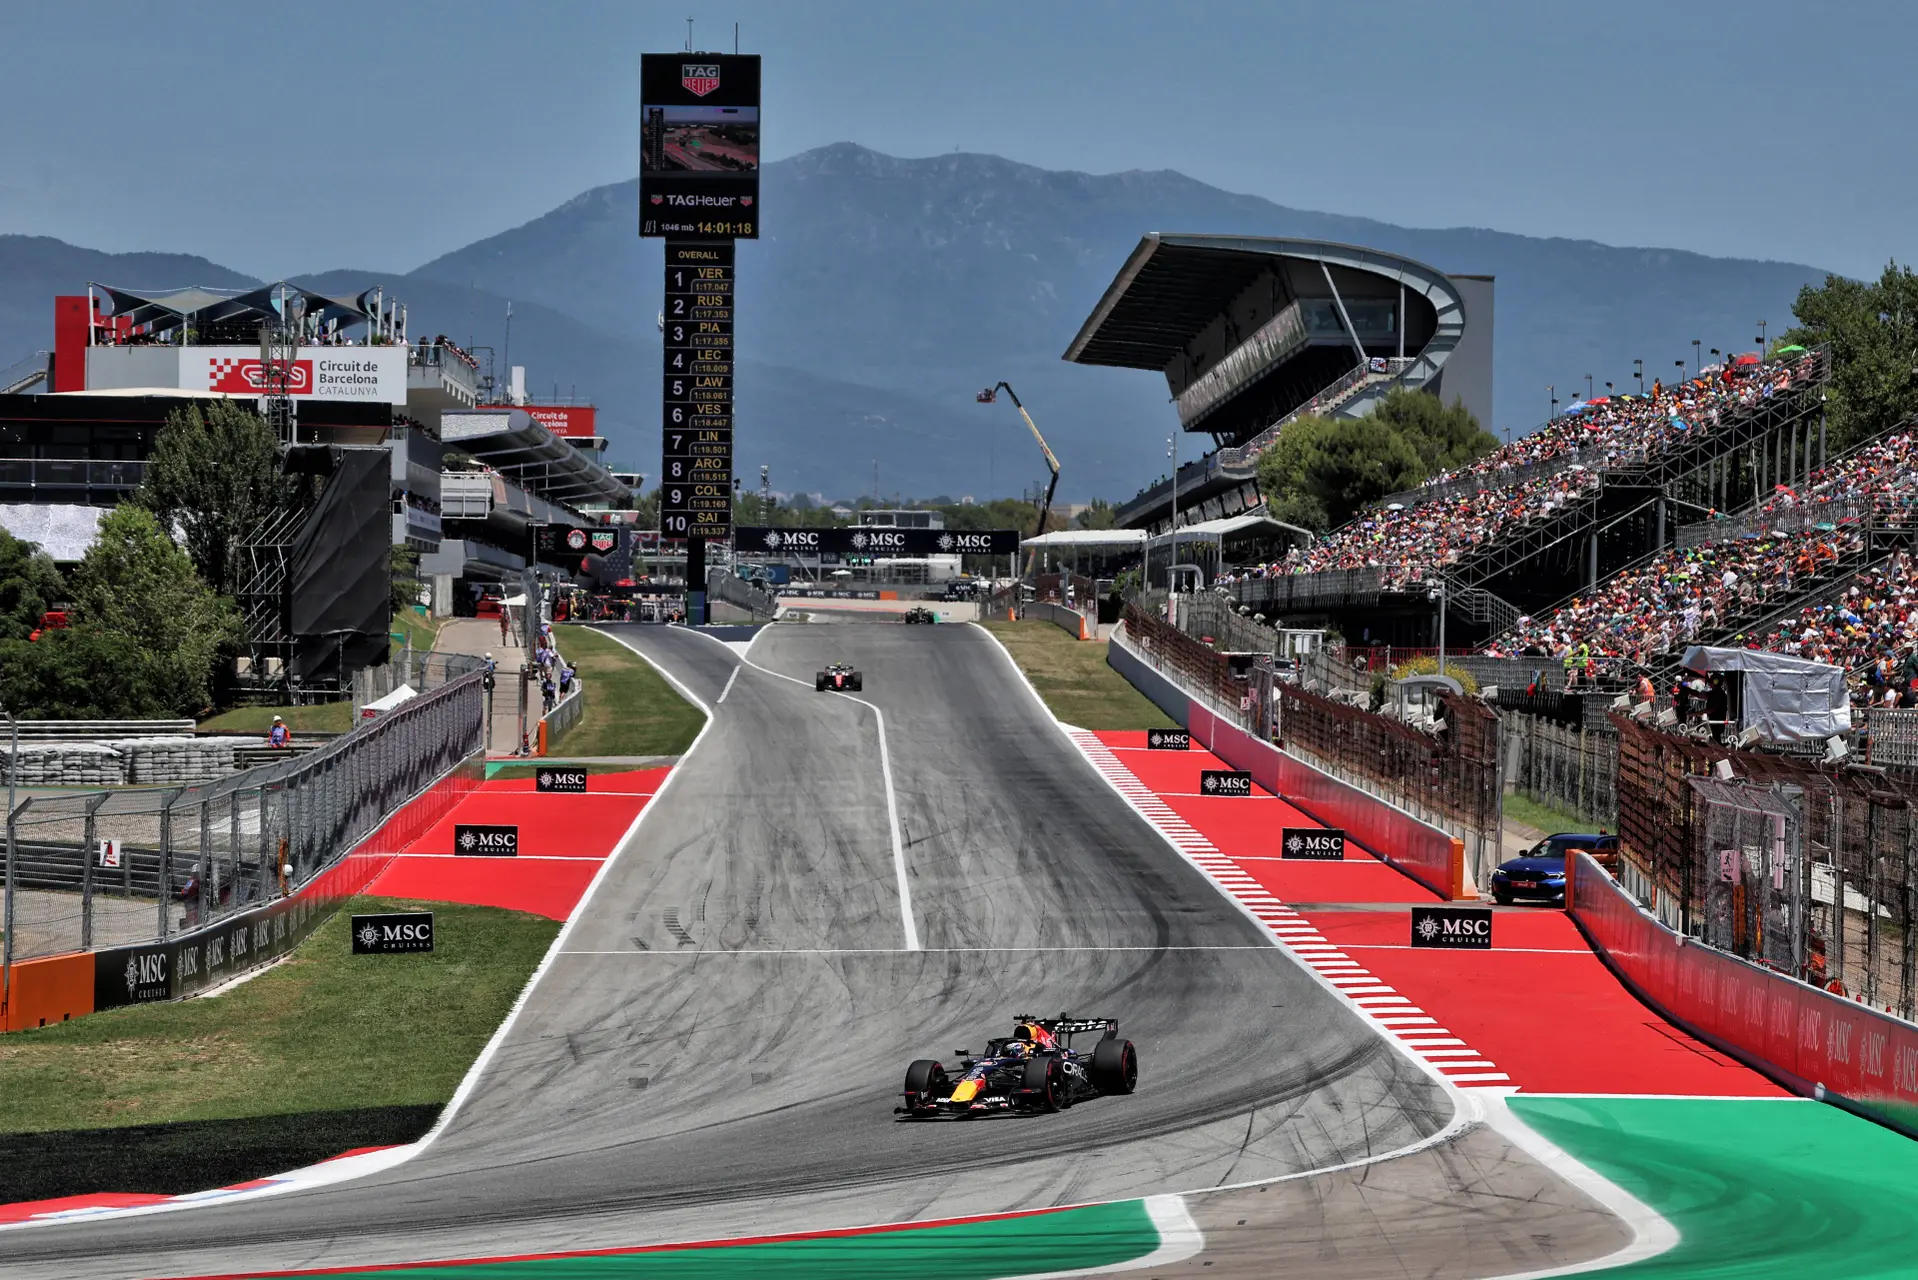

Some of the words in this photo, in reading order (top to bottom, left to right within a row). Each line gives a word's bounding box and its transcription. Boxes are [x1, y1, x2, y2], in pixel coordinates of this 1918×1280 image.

[686, 66, 716, 77] TAG
[684, 79, 718, 94] HEUER
[681, 224, 694, 232] mb
[697, 222, 752, 234] 14:01:18
[678, 250, 719, 259] OVERALL
[674, 271, 682, 287] 1
[698, 268, 723, 278] VER
[674, 299, 684, 314] 2
[697, 296, 723, 306] RUS
[673, 326, 684, 341] 3
[700, 323, 720, 332] PIA
[319, 360, 361, 372] Circuit
[363, 361, 378, 372] de
[673, 354, 683, 368] 4
[697, 350, 721, 360] LEC
[319, 374, 378, 385] Barcelona
[673, 381, 683, 395] 5
[696, 377, 723, 387] LAW
[319, 386, 378, 396] CATALUNYA
[531, 412, 557, 420] Circuit
[672, 408, 683, 422] 6
[697, 404, 721, 414] VES
[672, 435, 682, 449] 7
[700, 431, 718, 441] LIN
[672, 462, 682, 477] 8
[695, 458, 722, 468] ARO
[671, 489, 682, 503] 9
[695, 486, 720, 495] COL
[666, 516, 686, 531] 10
[697, 512, 718, 522] SAI
[783, 532, 819, 545] MSC
[870, 533, 904, 546] MSC
[956, 535, 991, 547] MSC
[1163, 734, 1189, 744] MSC
[555, 774, 585, 784] MSC
[1220, 778, 1249, 788] MSC
[478, 833, 516, 847] MSC
[1306, 836, 1342, 850] MSC
[383, 924, 430, 941] MSC
[1443, 918, 1489, 935] MSC
[236, 927, 248, 956] MSC
[212, 936, 224, 967] MSC
[139, 954, 166, 984] MSC
[184, 946, 199, 976] MSC
[139, 988, 166, 998] CRUISES
[1804, 1008, 1820, 1052] MSC
[1834, 1020, 1852, 1065] MSC
[1867, 1032, 1885, 1078] MSC
